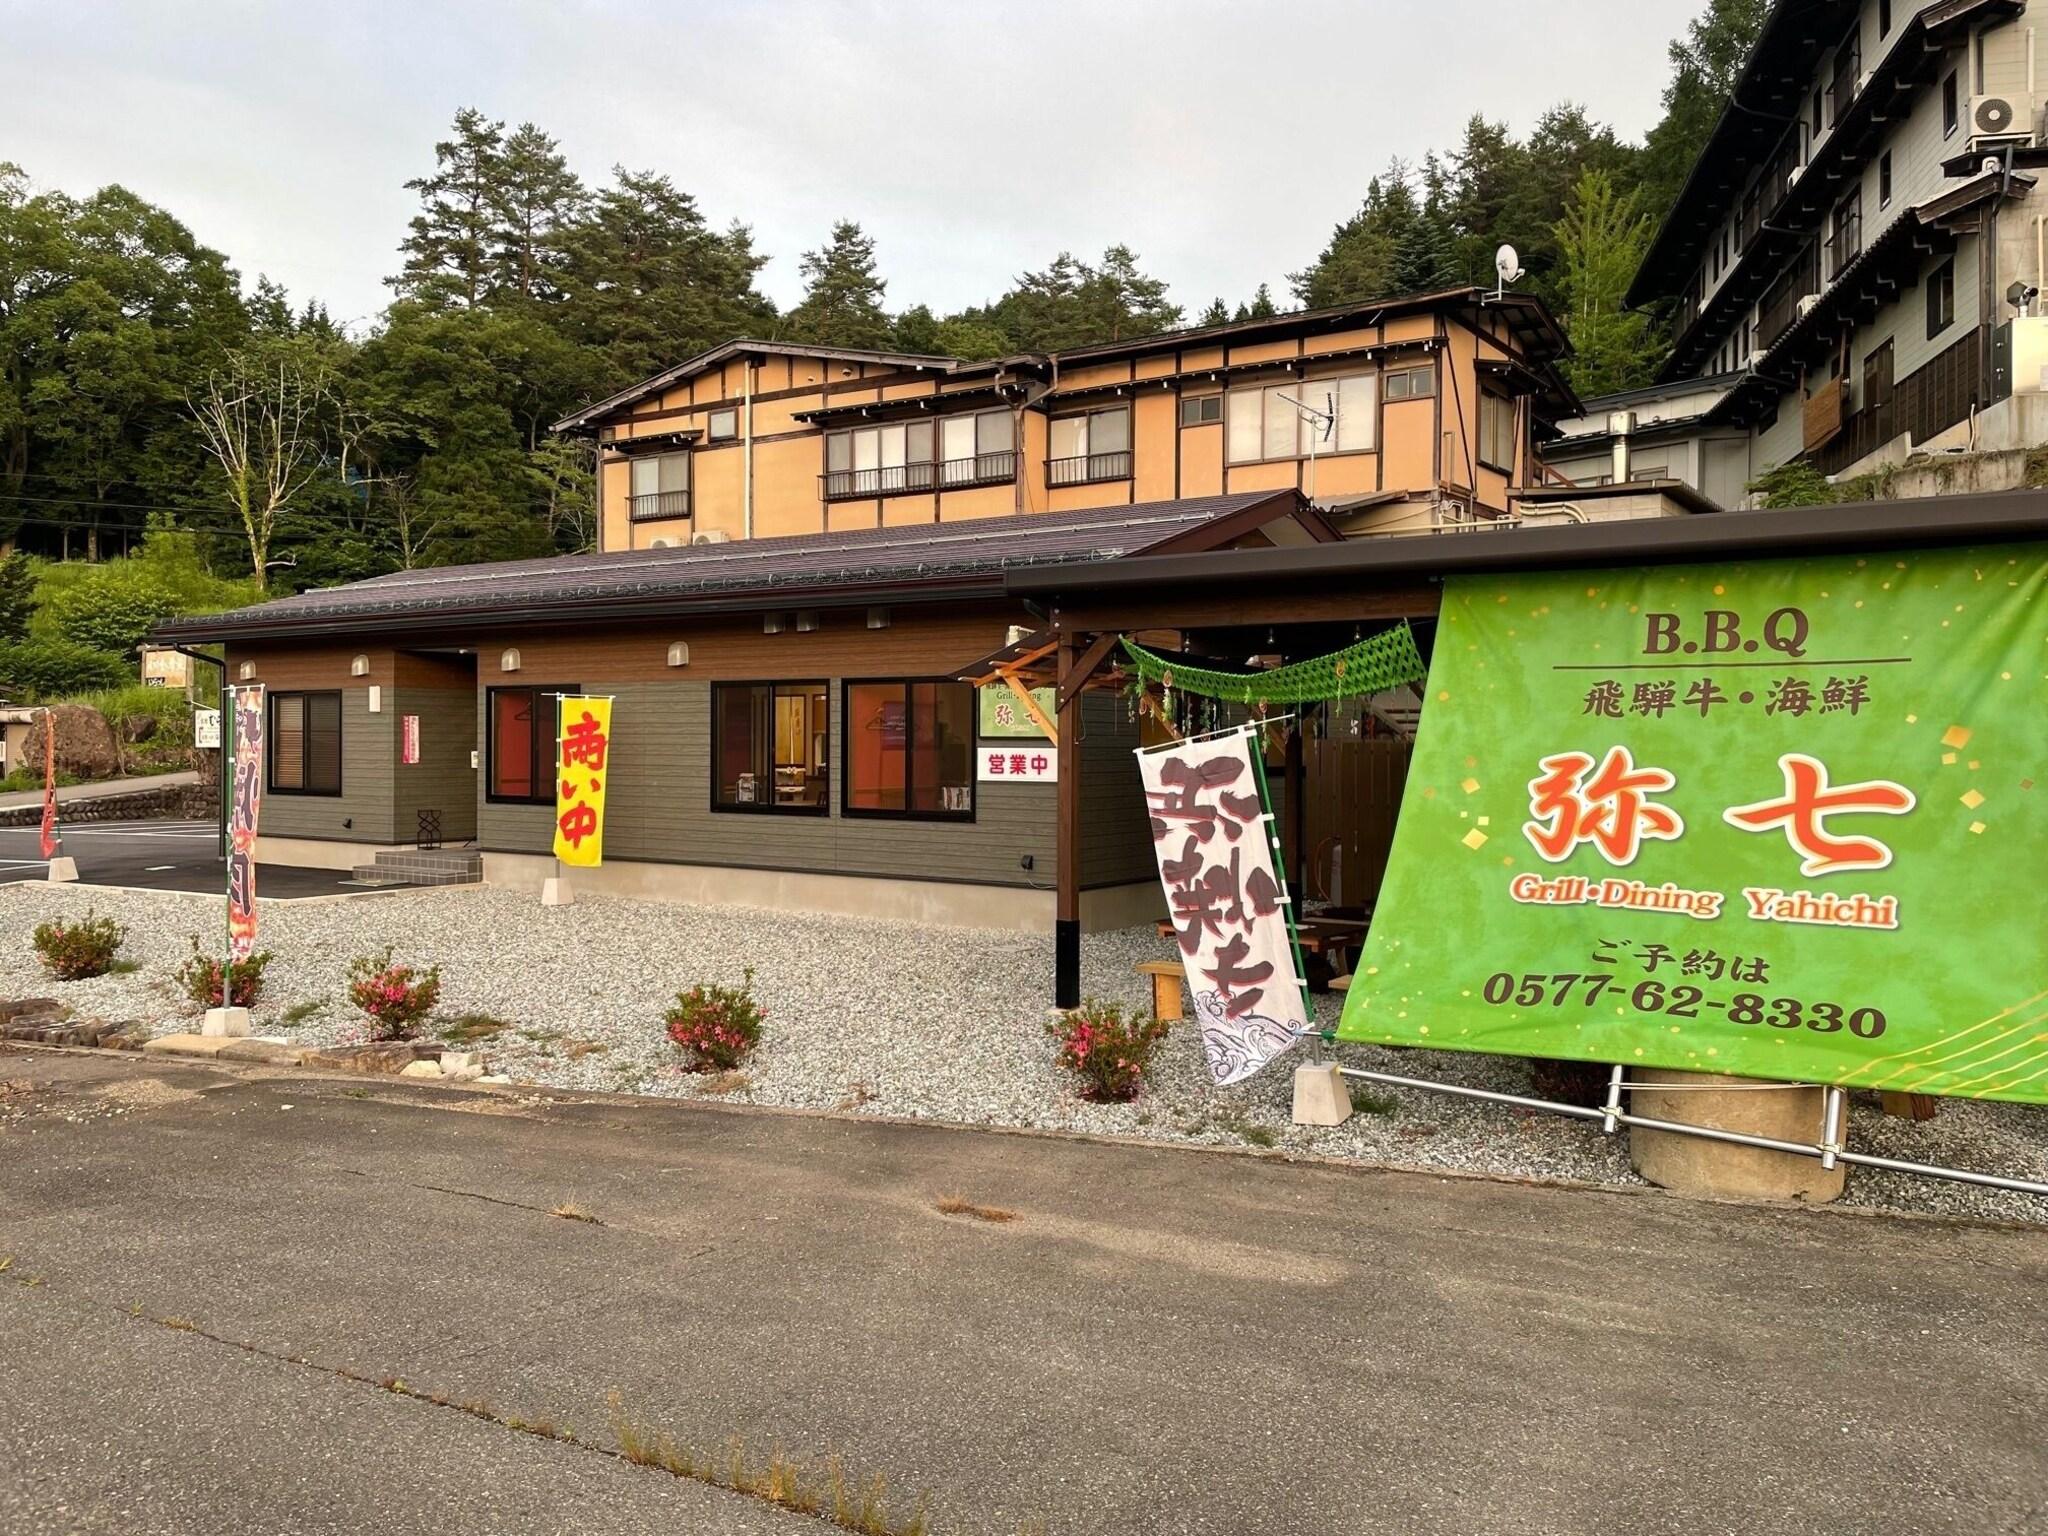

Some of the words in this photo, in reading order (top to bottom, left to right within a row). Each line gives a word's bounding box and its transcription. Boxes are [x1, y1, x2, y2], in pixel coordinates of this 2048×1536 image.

[1642, 607, 1809, 657] B.B.Q
[1582, 675, 1871, 719] 飛騨牛・海鮮
[559, 711, 608, 850] 商い中
[988, 754, 1048, 776] 営業中
[1744, 889, 1897, 927] Yahichi
[1592, 939, 1770, 984] ご予約は
[1483, 973, 1886, 1038] 0577-62-8330
